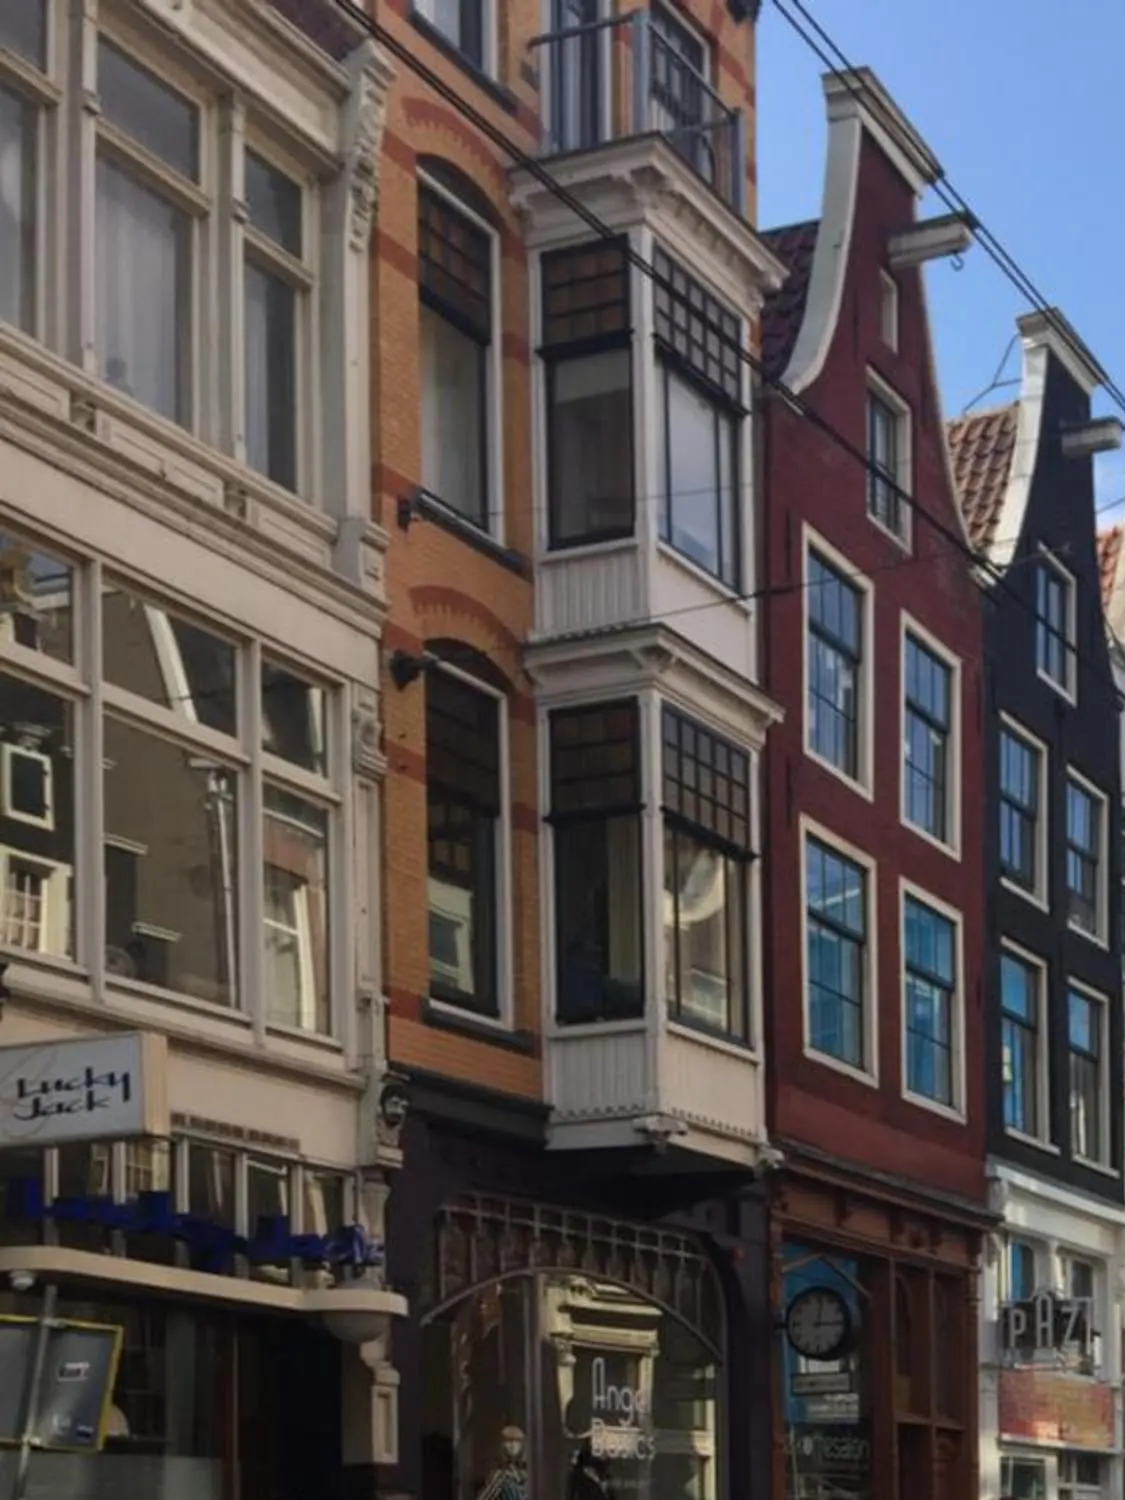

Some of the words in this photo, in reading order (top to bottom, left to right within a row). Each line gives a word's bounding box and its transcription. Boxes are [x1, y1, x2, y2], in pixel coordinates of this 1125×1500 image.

[17, 1065, 130, 1103] Lucky
[13, 1089, 111, 1121] Jack
[592, 1357, 651, 1427] Ange
